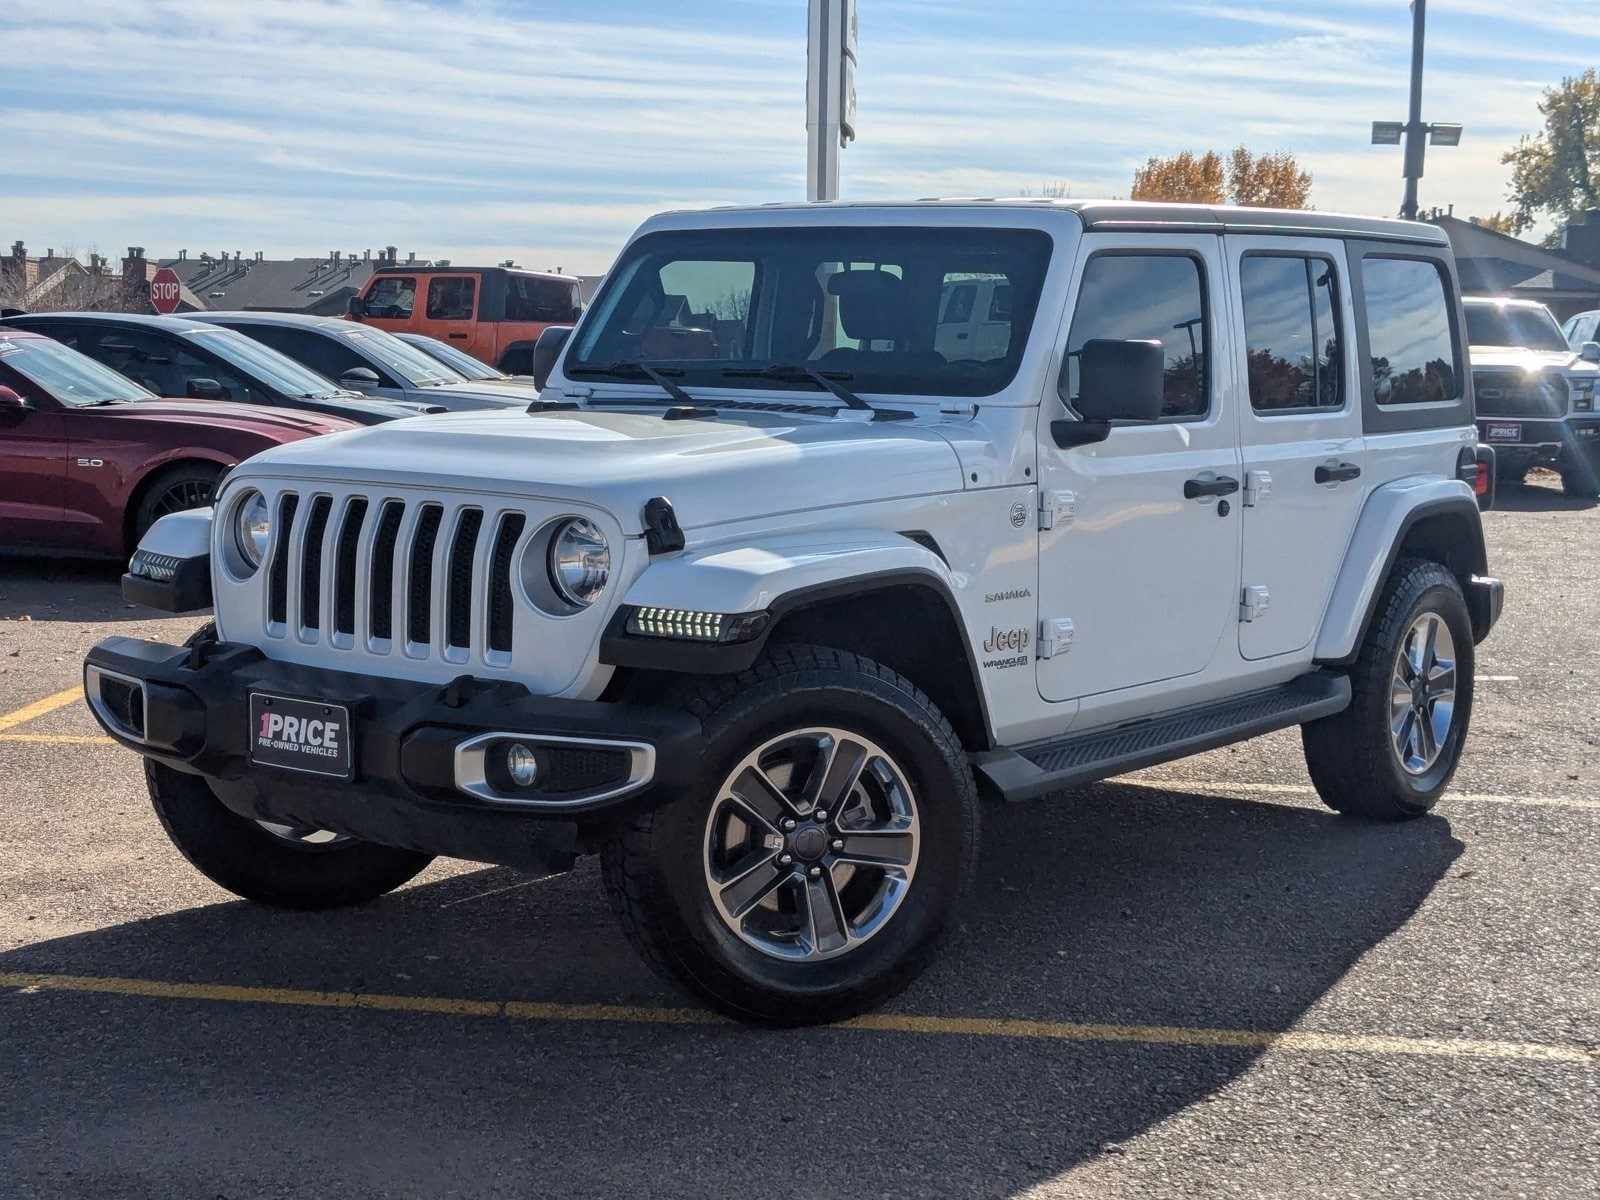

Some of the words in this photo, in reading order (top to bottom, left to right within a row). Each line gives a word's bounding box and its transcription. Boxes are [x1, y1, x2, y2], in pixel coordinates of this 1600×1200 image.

[152, 283, 179, 300] STOP
[984, 588, 1031, 603] SAHARA
[983, 626, 1030, 653] Jeep
[983, 655, 1028, 668] WRANGLER
[259, 712, 340, 748] 1PRICE
[258, 737, 299, 751] PRE-OWNED
[301, 745, 338, 758] VEHICLES
